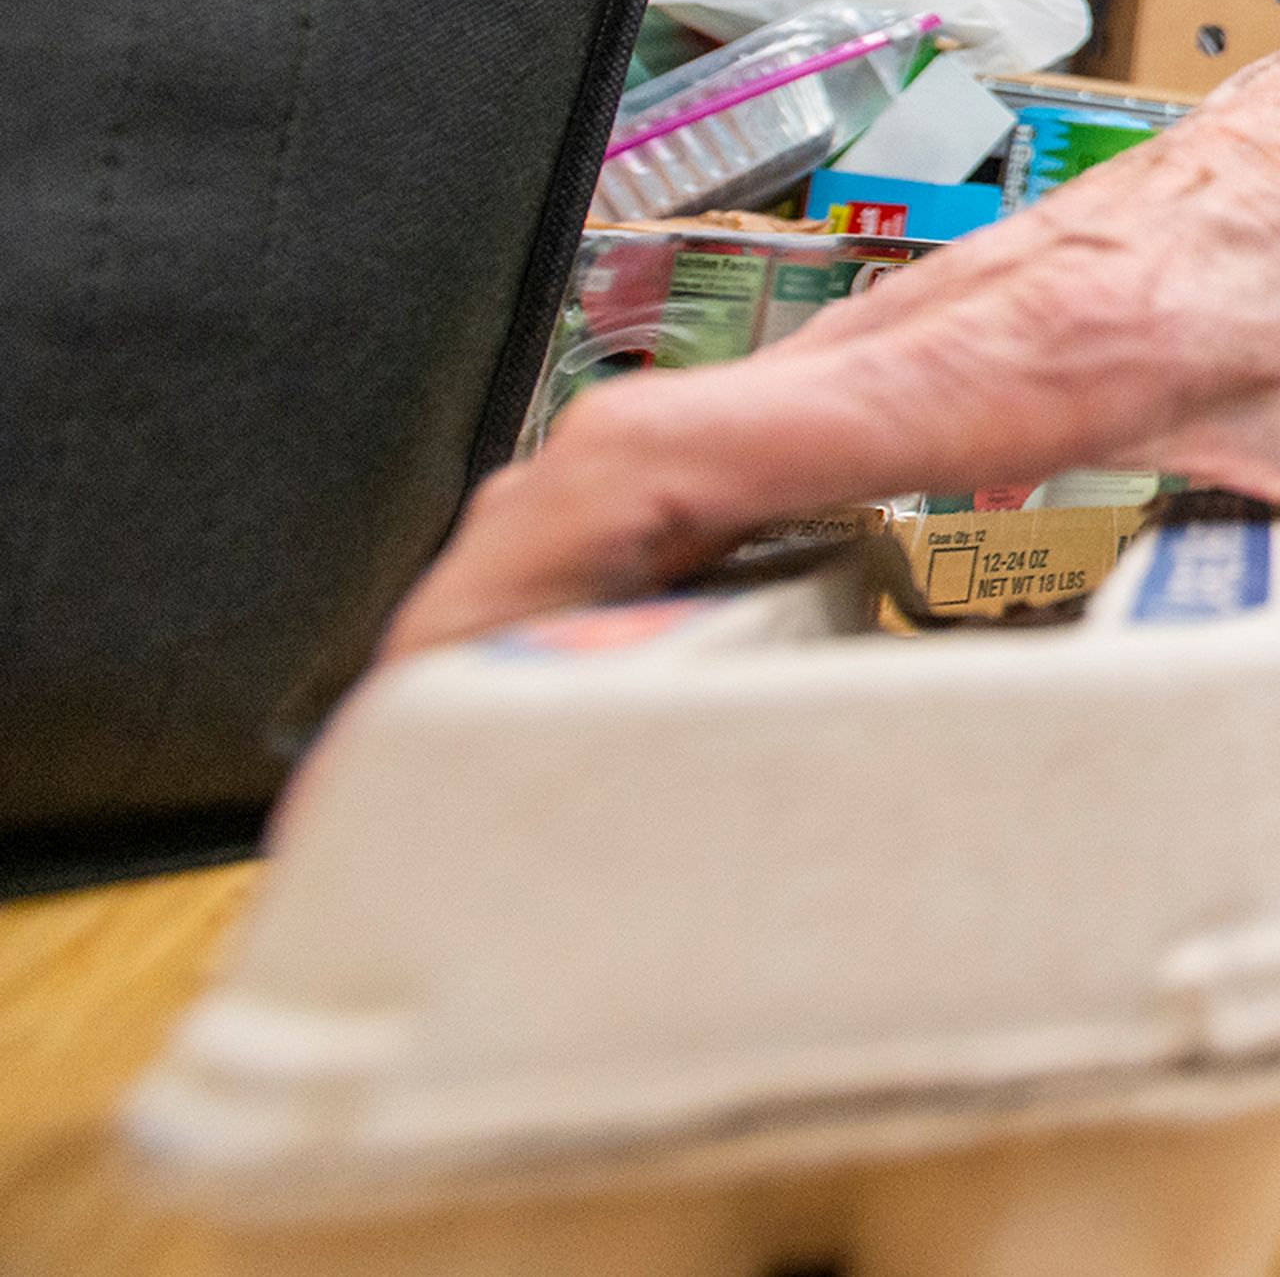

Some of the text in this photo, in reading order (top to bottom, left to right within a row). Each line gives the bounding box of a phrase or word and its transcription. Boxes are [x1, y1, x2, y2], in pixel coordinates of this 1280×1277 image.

[975, 529, 987, 543] 12
[982, 549, 1050, 574] 12-24 OZ
[976, 571, 1087, 600] NET WT 18 LBS
